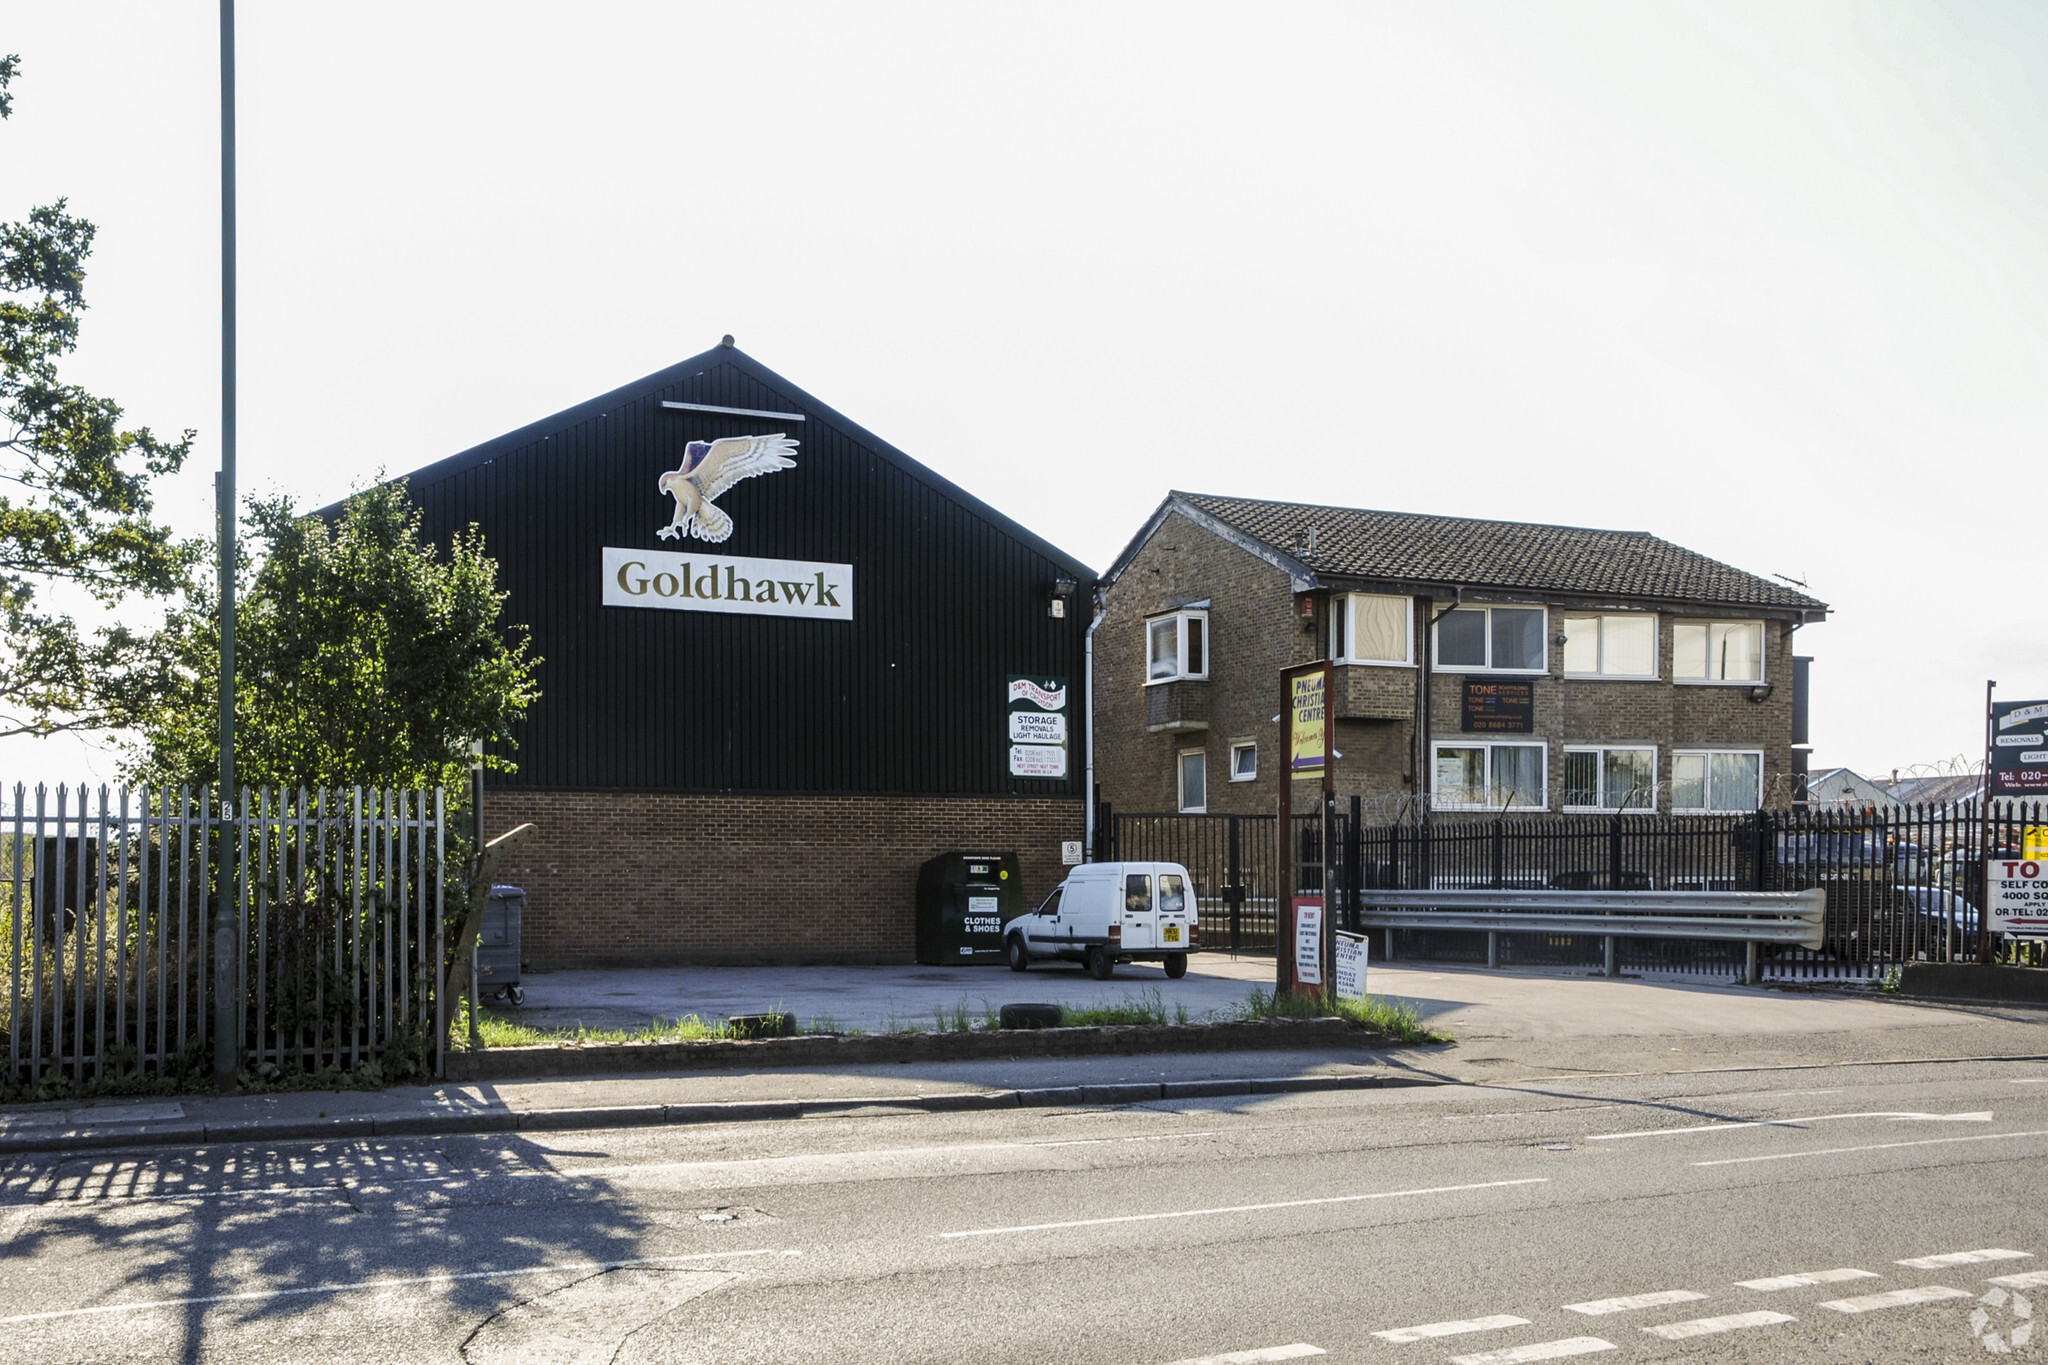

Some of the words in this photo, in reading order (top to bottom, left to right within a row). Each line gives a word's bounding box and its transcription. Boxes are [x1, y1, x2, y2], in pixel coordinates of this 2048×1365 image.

[617, 561, 841, 607] Goldhawk
[1028, 683, 1061, 702] TRANSPORT
[1469, 685, 1497, 695] TONE
[1298, 706, 1325, 723] CENTRE
[1017, 715, 1058, 725] STORAGE
[1033, 732, 1062, 740] HAULAGE
[2000, 736, 2040, 744] REMOVALS
[1999, 771, 2015, 781] Tel:
[2002, 861, 2040, 878] TO
[2001, 880, 2028, 889] SELF
[2002, 891, 2030, 900] 4000
[1995, 908, 2009, 916] OR
[2012, 908, 2033, 916] TEL:
[964, 917, 1001, 925] CLOTHES
[973, 925, 1000, 933] SHOES
